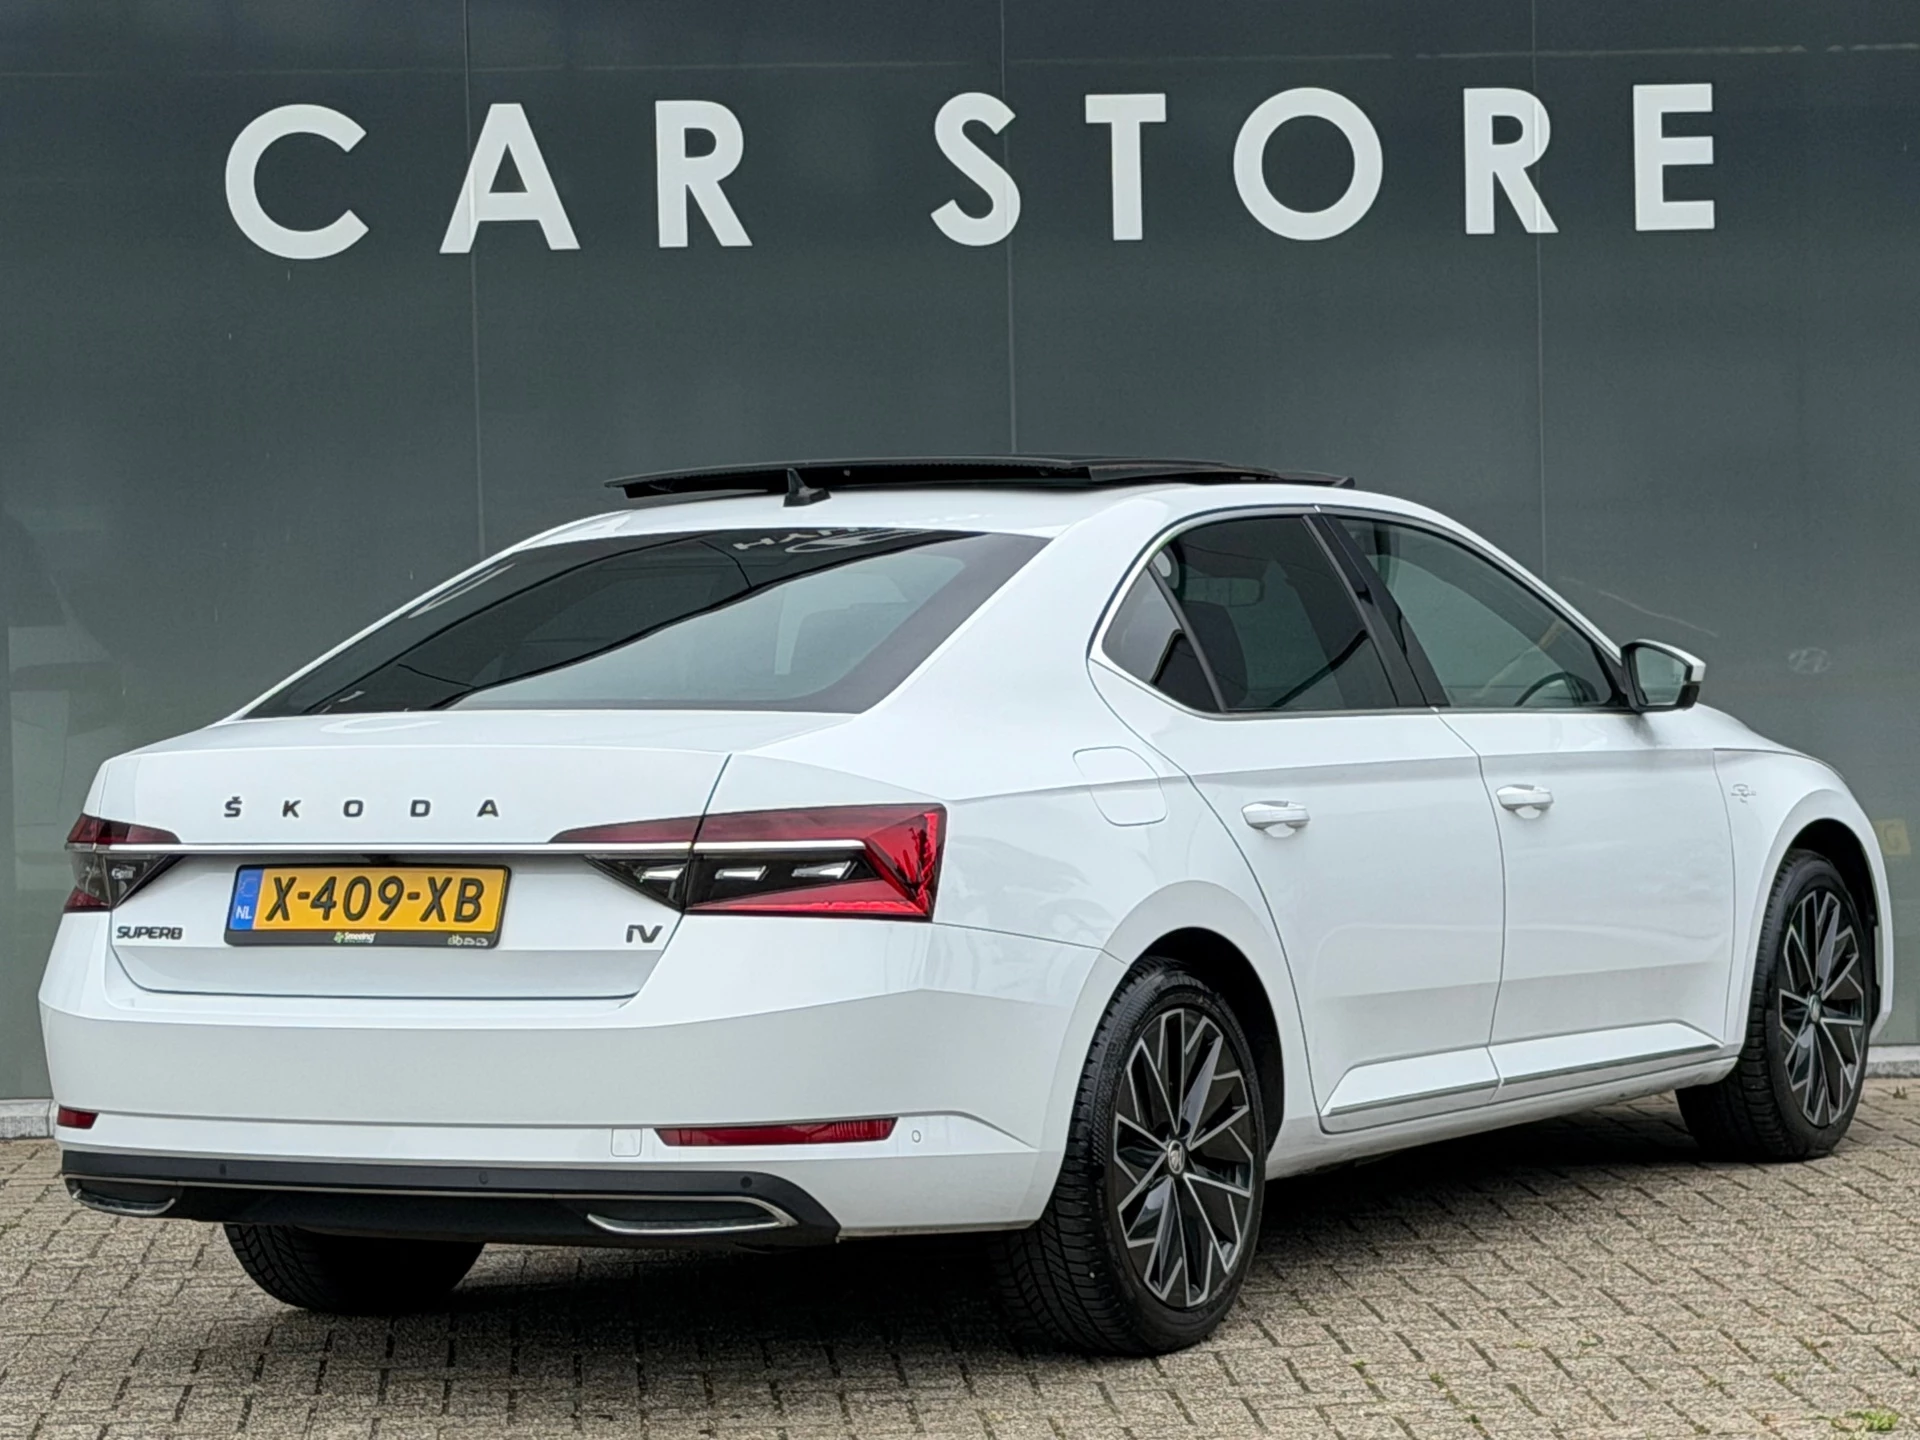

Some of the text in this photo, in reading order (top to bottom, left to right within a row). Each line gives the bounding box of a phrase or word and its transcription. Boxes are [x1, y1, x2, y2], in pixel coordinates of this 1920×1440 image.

[225, 84, 1716, 259] CAR STORE
[223, 796, 500, 818] ŠKODA
[265, 875, 485, 923] X-409-XB
[235, 906, 252, 919] NL
[116, 926, 183, 940] SUPERB
